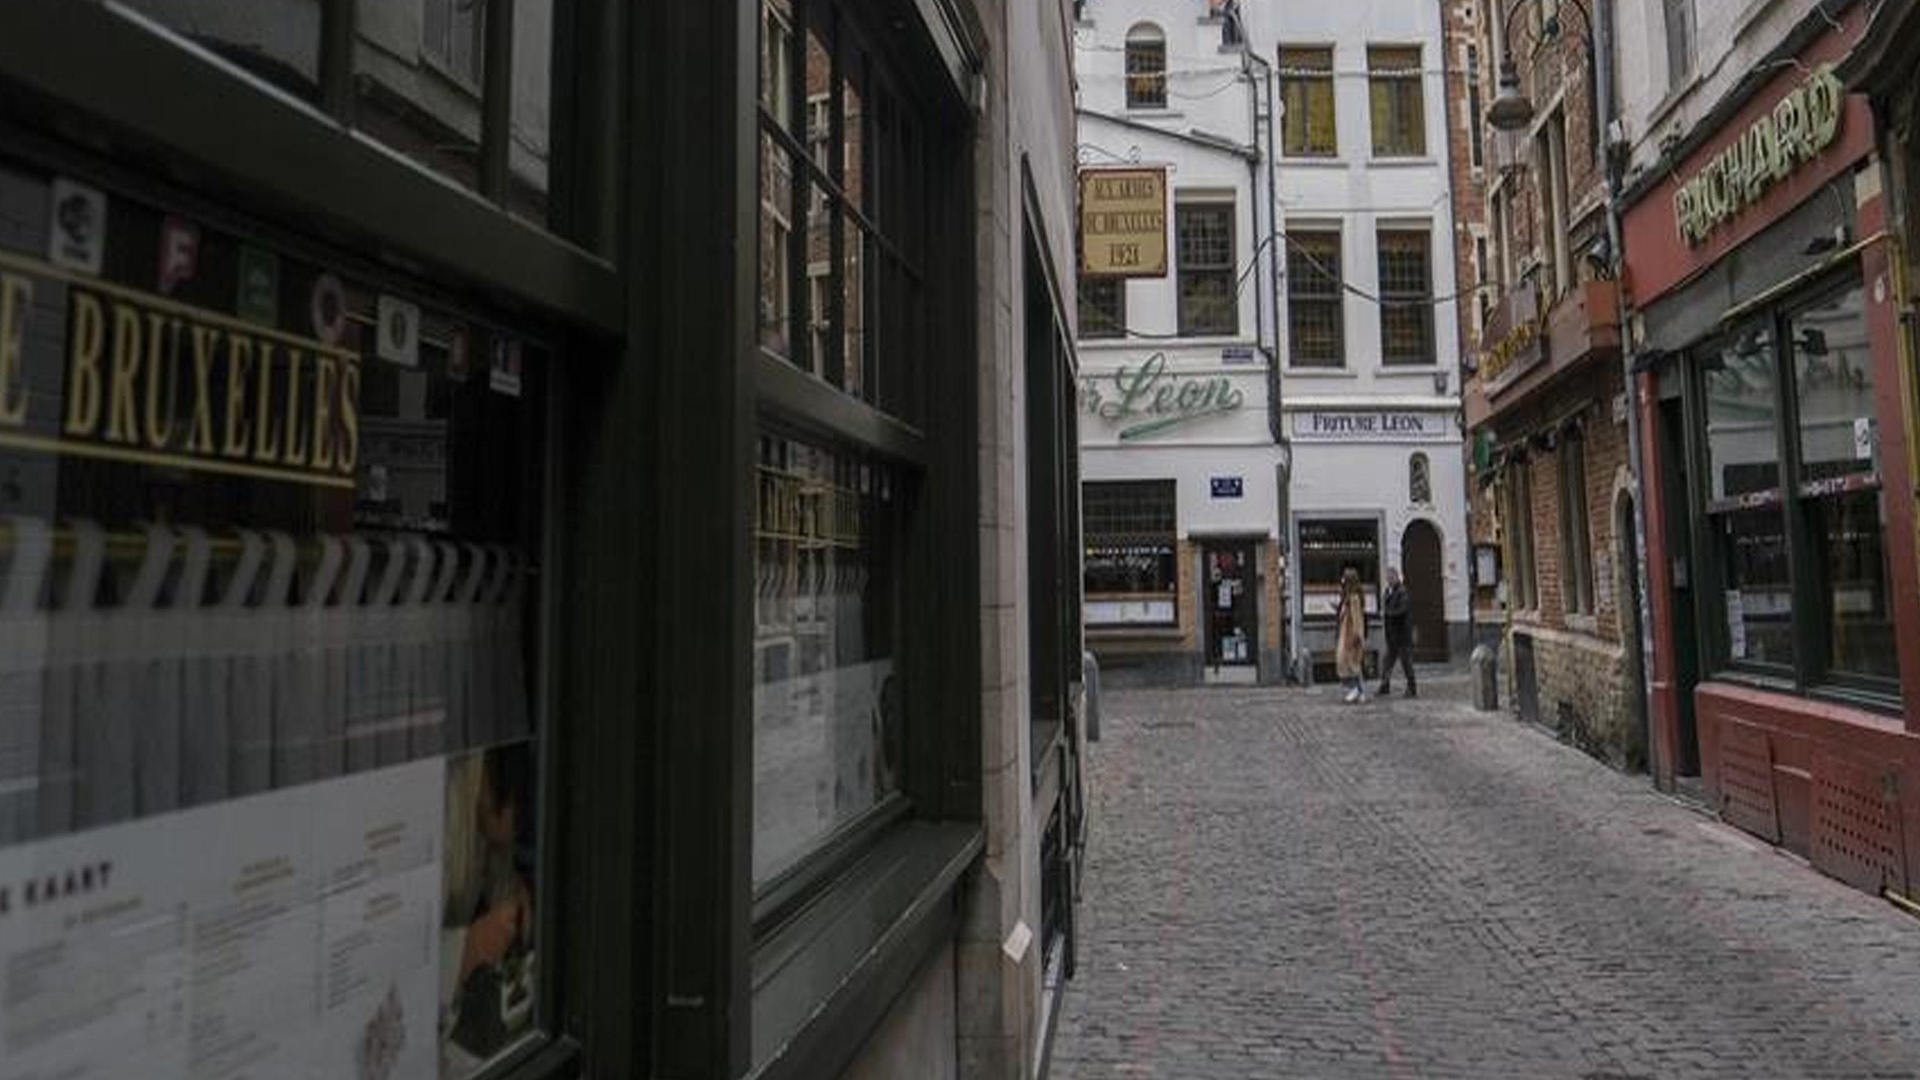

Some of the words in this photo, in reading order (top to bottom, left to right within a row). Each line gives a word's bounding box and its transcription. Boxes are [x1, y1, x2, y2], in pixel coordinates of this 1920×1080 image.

[1676, 68, 1844, 245] RICHARD
[65, 292, 361, 473] BRUXELLES
[1313, 414, 1376, 432] FRITURE
[1381, 414, 1425, 432] LEON
